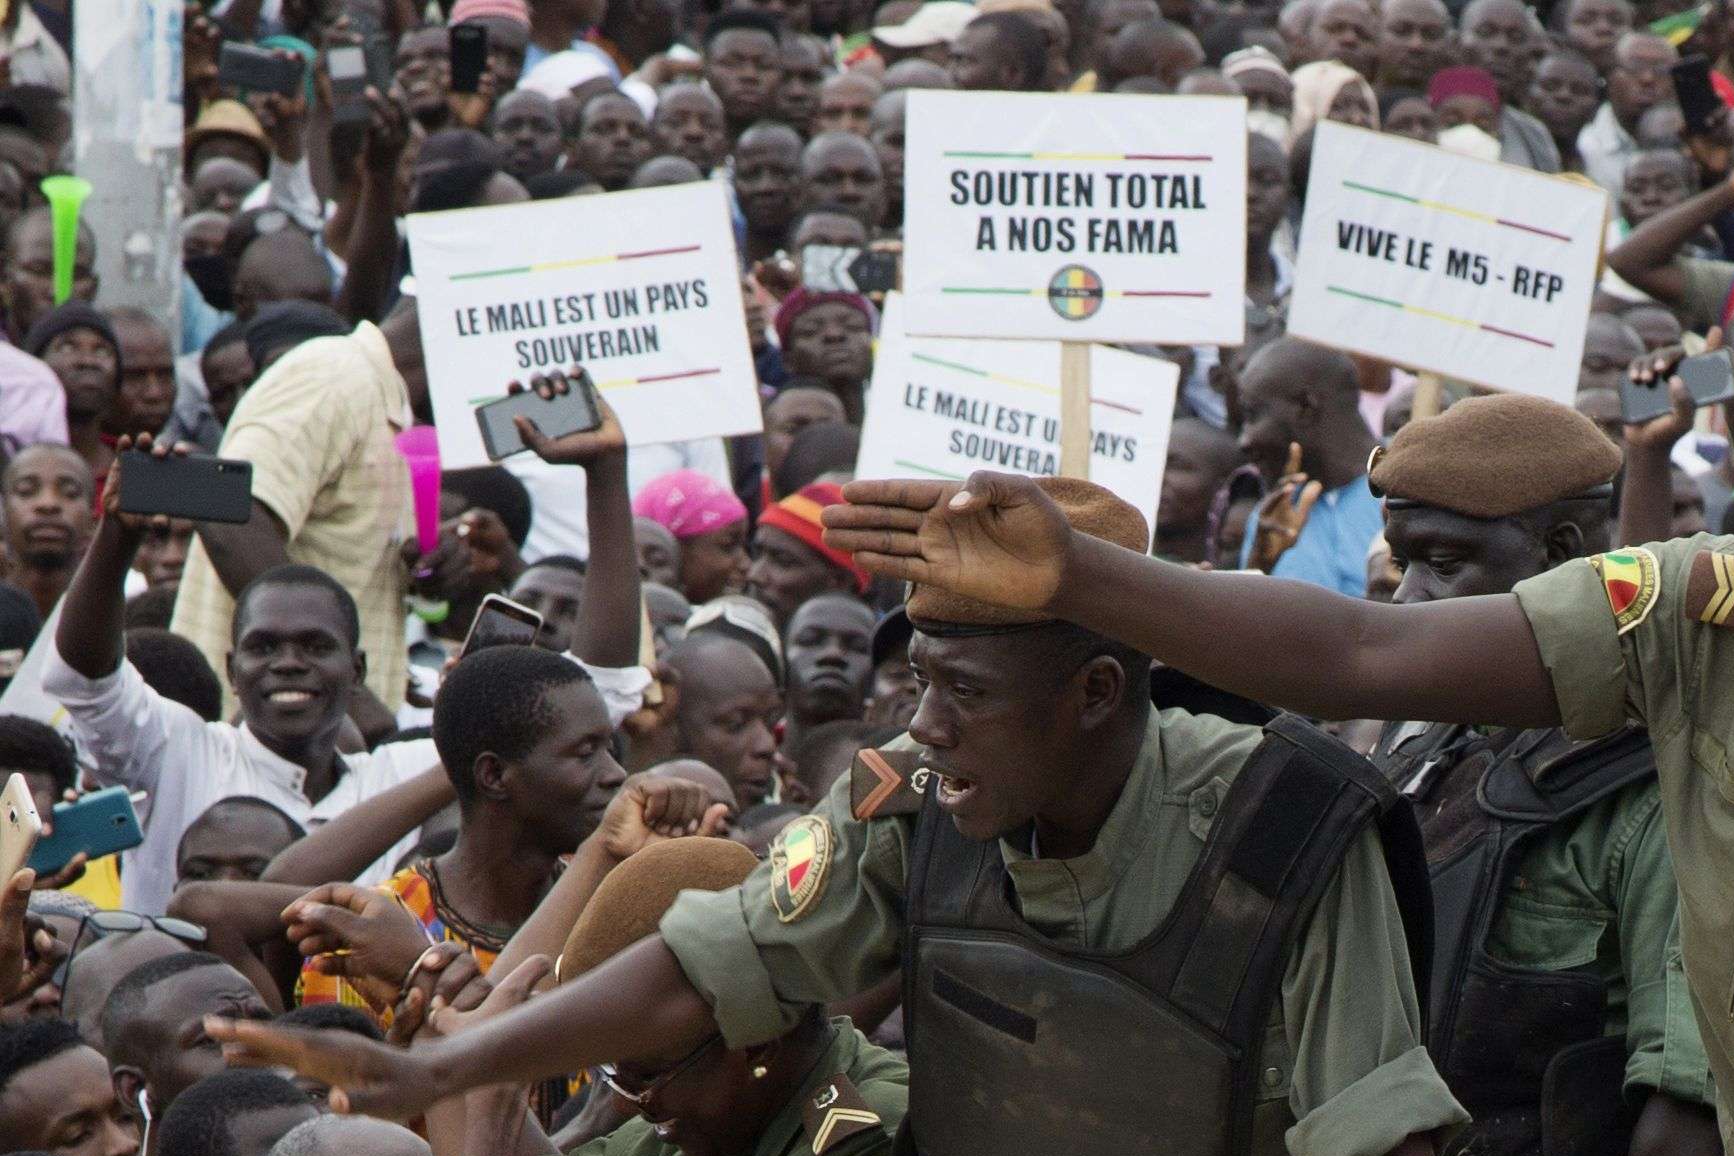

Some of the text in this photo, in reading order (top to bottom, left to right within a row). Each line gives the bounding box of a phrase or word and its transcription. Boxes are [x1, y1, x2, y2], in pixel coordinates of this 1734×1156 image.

[950, 170, 1206, 210] SOUTIEN TOTAL
[976, 216, 1179, 254] A NOS FAMA
[1336, 220, 1398, 262] VIVE
[1405, 238, 1433, 271] LE
[1446, 247, 1488, 285] M5
[1513, 266, 1563, 303] RFP
[455, 279, 709, 336] LE MALI EST UN PAYS
[515, 325, 661, 368] SOUVERAIN
[904, 383, 927, 409] LE
[934, 391, 990, 427] MALI
[995, 406, 1037, 438] EST
[1044, 417, 1060, 445] U
[949, 430, 1057, 476] SOUVERA
